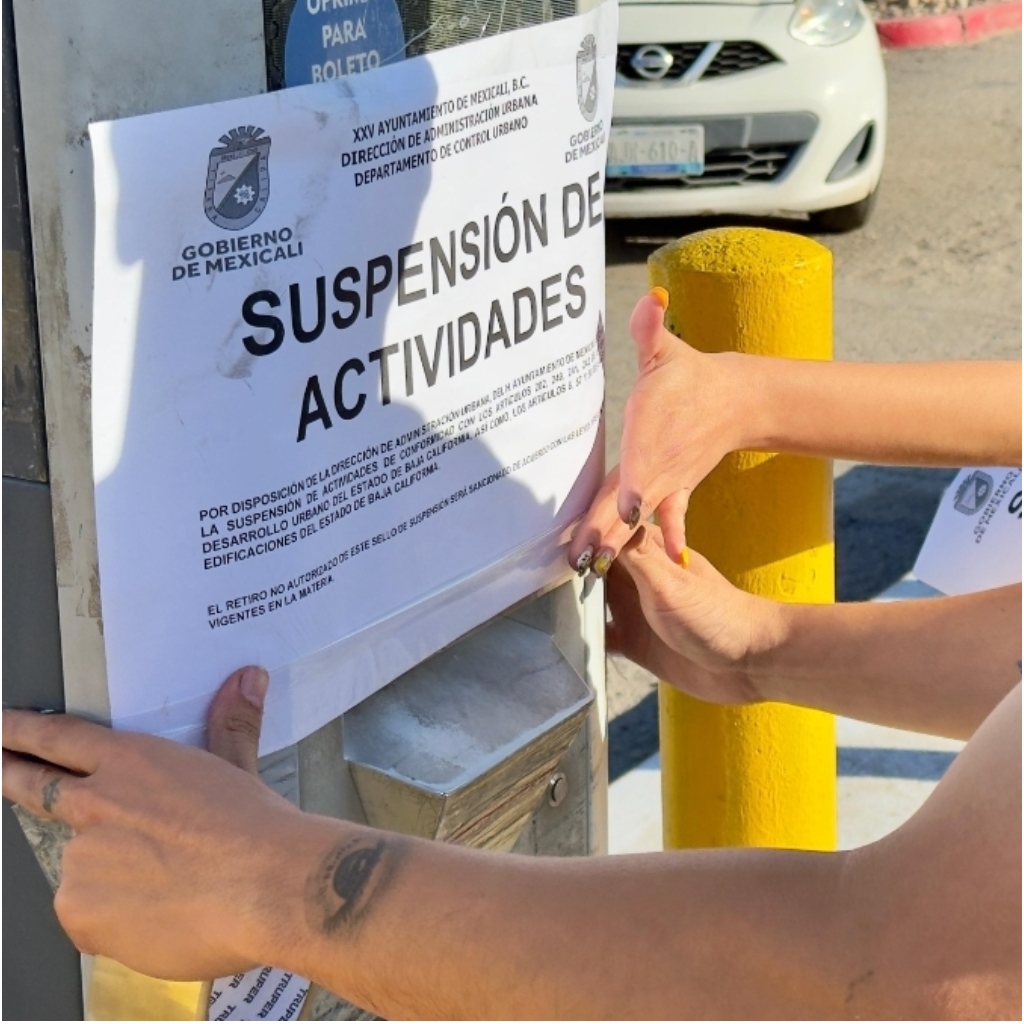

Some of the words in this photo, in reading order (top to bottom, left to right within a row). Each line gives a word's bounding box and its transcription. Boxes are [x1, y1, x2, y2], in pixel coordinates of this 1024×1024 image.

[322, 18, 366, 48] PARA
[341, 134, 405, 168] DIRECCIÓN
[408, 131, 422, 148] DE
[424, 103, 500, 143] ADMINISTRACIÓN
[501, 93, 538, 115] URBANA
[353, 124, 374, 143] XXV
[378, 101, 455, 136] AYUNTAMIENTO
[457, 95, 468, 110] DE
[470, 81, 510, 107] MEXICALI,
[512, 75, 530, 92] B.C.
[354, 148, 436, 188] DEPARTAMENTO
[440, 143, 452, 159] DE
[454, 127, 491, 154] CONTROL
[493, 115, 528, 139] URBANO
[565, 149, 578, 163] DE
[172, 262, 201, 281] DE
[205, 241, 303, 275] MEXICALI
[182, 227, 293, 261] GOBIERNO
[241, 192, 548, 357] SUSPENSIÓN
[562, 171, 603, 239] DE
[296, 265, 586, 443] ACTIVIDADES
[199, 505, 229, 521] POR
[232, 481, 305, 514] DISPOSICIÓN
[306, 474, 317, 488] DE
[319, 469, 330, 483] LA
[331, 445, 379, 475] DIRECCIÓN
[381, 441, 393, 454] DE
[201, 524, 219, 538] LA
[227, 498, 302, 531] SUSPENSIÓN
[307, 490, 318, 505] DE
[322, 461, 378, 496] ACTIVIDADES
[383, 454, 396, 468] DE
[399, 425, 455, 460] CONFORMIDAD
[202, 520, 289, 554] DESARROLLO
[291, 500, 330, 526] URBANO
[332, 490, 348, 506] DEL
[350, 473, 388, 497] ESTADO
[391, 465, 402, 480] DE
[405, 455, 425, 476] BAJA
[204, 531, 298, 570] EDIFICACIONES
[300, 524, 318, 540] DEL
[319, 504, 352, 529] ESTADO
[353, 497, 366, 512] DE
[367, 487, 393, 504] BAJA
[207, 604, 223, 616] EL
[226, 590, 268, 611] RETIRO
[270, 584, 286, 597] NO
[287, 557, 338, 591] AUTORIZADO
[339, 550, 349, 563] DE
[350, 539, 370, 557] ESTE
[371, 527, 397, 546] SELLO
[397, 522, 408, 534] DE
[409, 498, 450, 527] SUSPENSIÓN
[209, 604, 266, 629] VIGENTES
[268, 599, 283, 612] EN
[284, 593, 297, 606] LA
[299, 575, 335, 600] MATERIA.
[243, 966, 273, 1004] RUPER
[257, 972, 292, 1018] TRUPER
